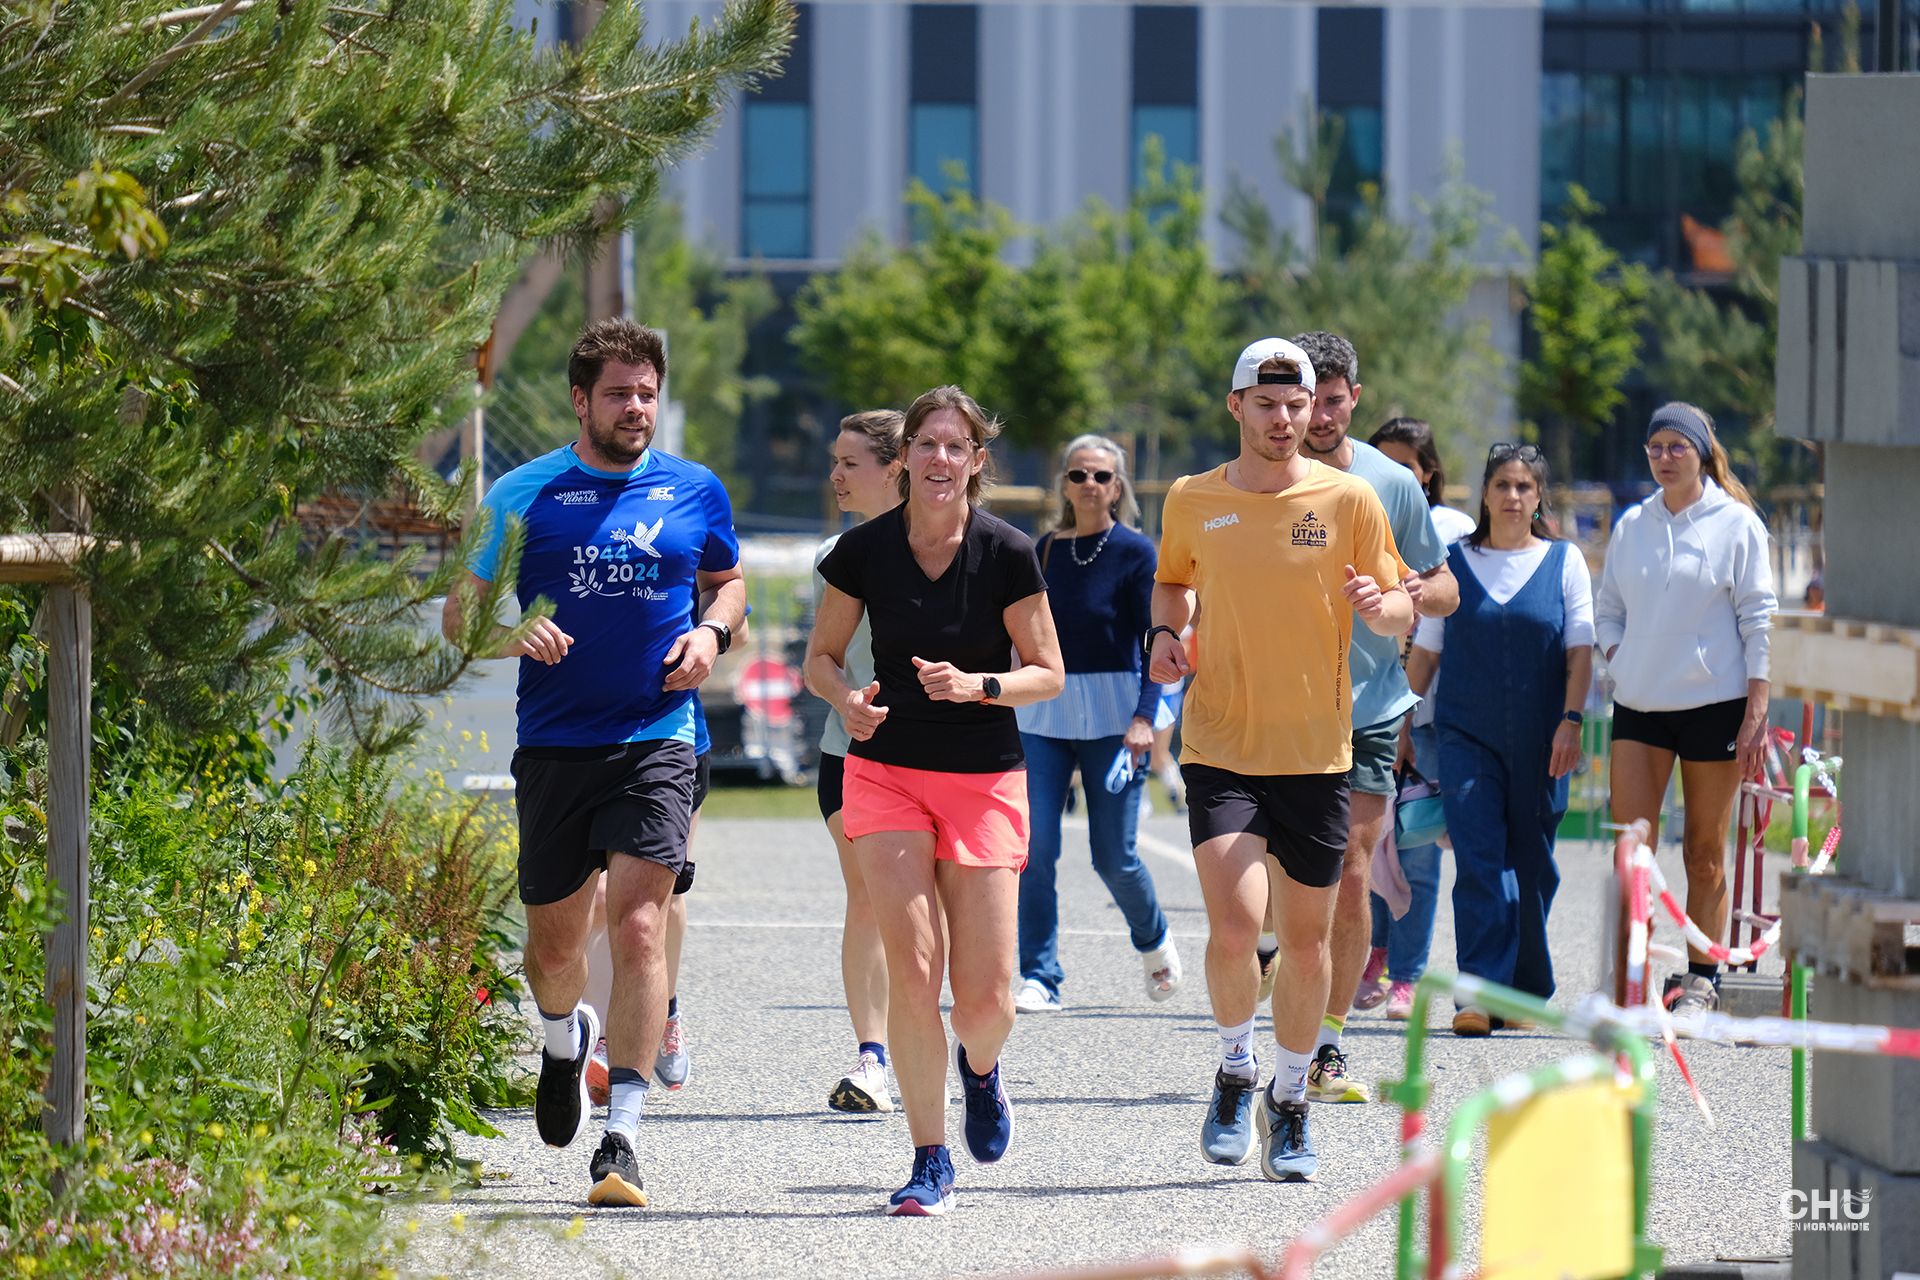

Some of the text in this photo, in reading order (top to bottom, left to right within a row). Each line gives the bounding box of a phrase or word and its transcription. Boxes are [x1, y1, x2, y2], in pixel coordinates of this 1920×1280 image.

[1204, 512, 1240, 532] HOKA
[1292, 529, 1327, 539] UTMB
[573, 544, 629, 565] 1944
[607, 563, 660, 583] 2024
